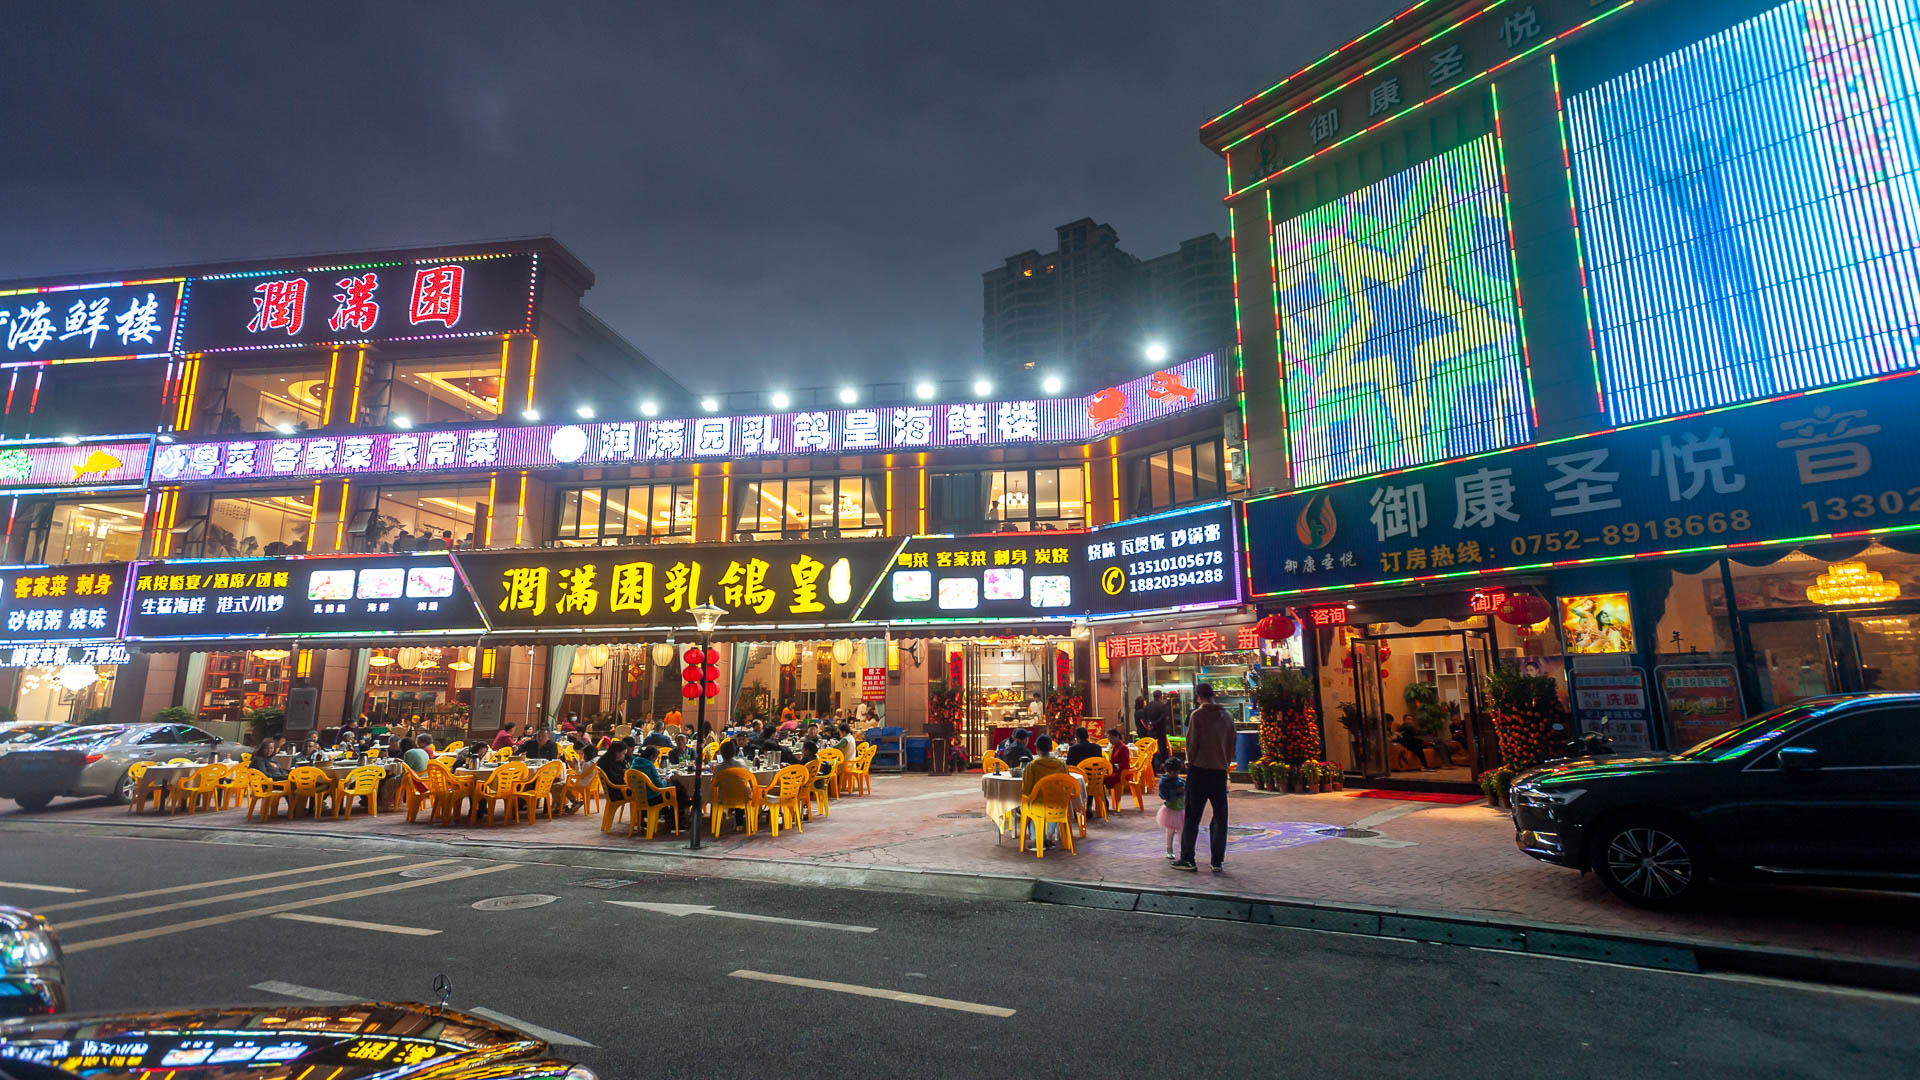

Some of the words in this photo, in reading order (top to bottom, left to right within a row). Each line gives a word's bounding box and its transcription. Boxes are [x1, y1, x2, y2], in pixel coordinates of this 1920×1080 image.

[1308, 7, 1542, 144] 御康圣悦
[0, 293, 162, 352] 海鲜楼
[600, 401, 1039, 460] 润满园乳鸽皇海鲜楼
[192, 441, 257, 475] 粤菜
[272, 437, 373, 473] 客家菜
[387, 431, 500, 467] 家常菜
[1087, 541, 1116, 561] 烧味
[1120, 533, 1166, 556] 瓦煲饭
[1171, 523, 1221, 548] 砂锅粥
[897, 552, 929, 568] 粤菜
[936, 550, 987, 567] 客家菜
[994, 549, 1027, 566] 刺身
[1034, 547, 1069, 564] 炭烧
[1129, 551, 1223, 576] 13510105678
[1284, 550, 1357, 575] 御康圣悦
[14, 574, 69, 598] 客家菜
[75, 573, 113, 596] 刺身
[1129, 568, 1223, 593] 18820394288
[140, 597, 206, 615] 生猛海鲜
[216, 595, 285, 614] 港式小炒
[1312, 608, 1345, 625] 咨询
[7, 608, 64, 632] 砂锅粥
[67, 607, 108, 630] 烧味
